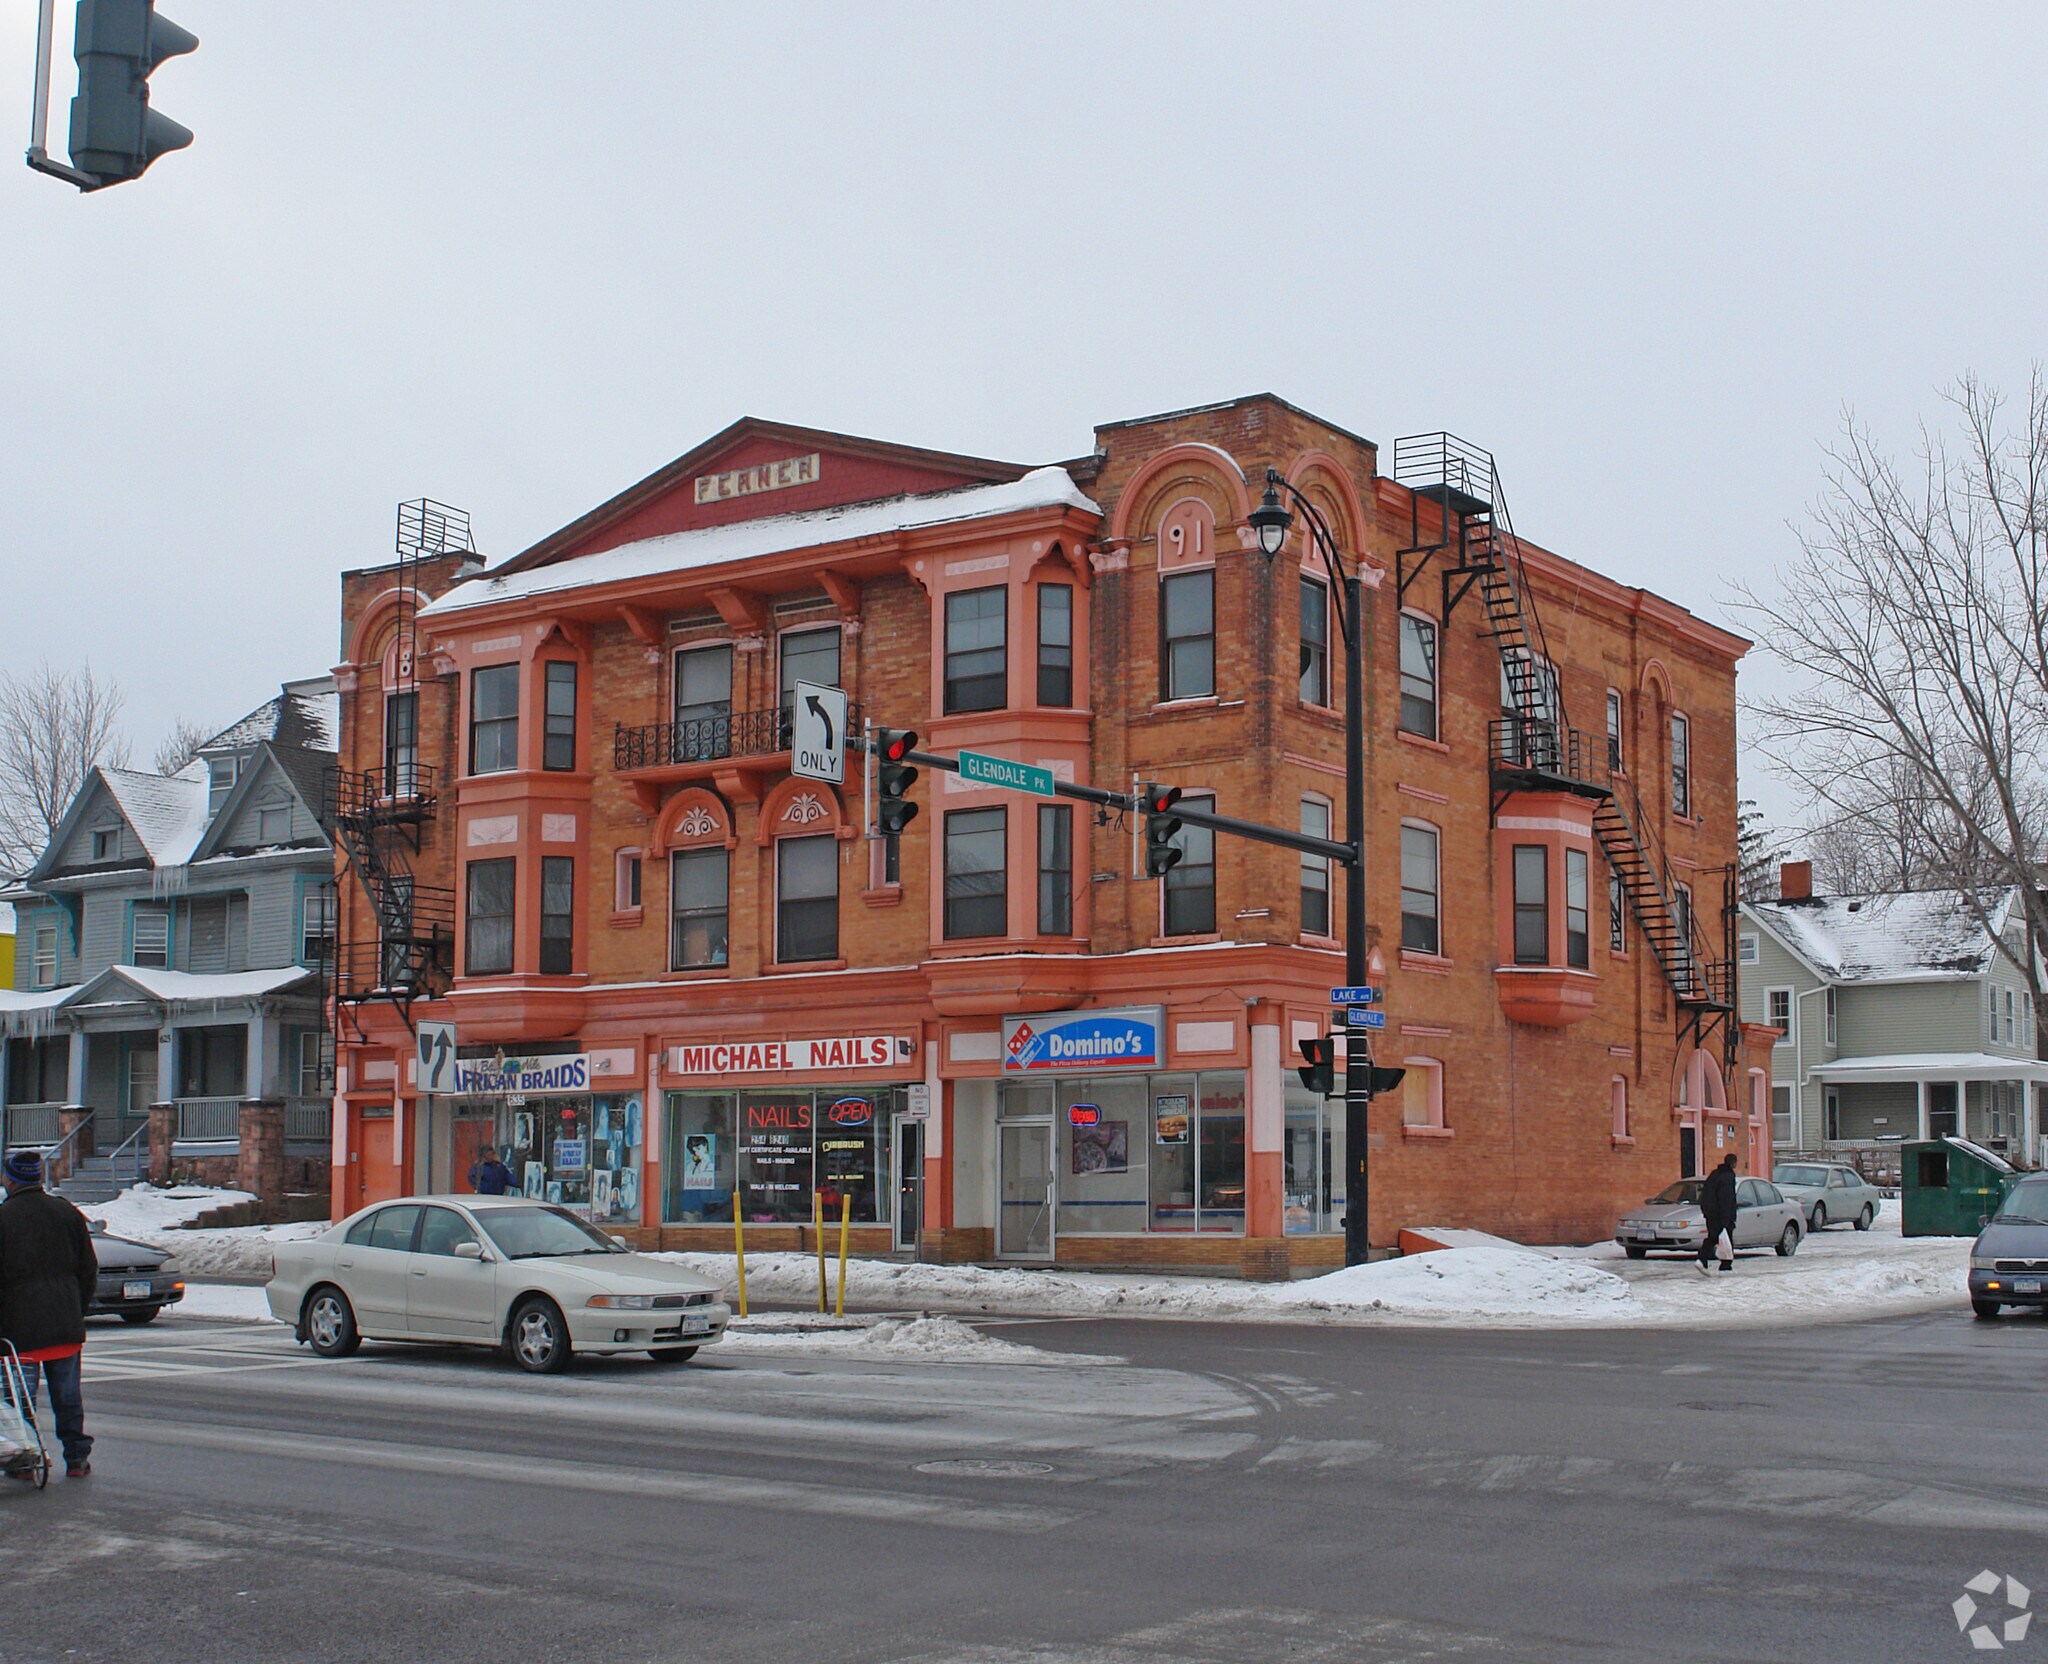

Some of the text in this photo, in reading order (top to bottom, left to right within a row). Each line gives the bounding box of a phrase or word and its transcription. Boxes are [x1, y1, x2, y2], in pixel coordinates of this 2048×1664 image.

[1169, 519, 1202, 556] 91
[800, 750, 837, 773] ONLY
[967, 758, 1045, 789] GLENDALE PK
[1332, 990, 1357, 1001] LAKE
[1350, 1011, 1378, 1024] GLENDALE
[683, 1038, 888, 1072] MICHAEL NAILS
[1050, 1030, 1142, 1057] Domino's
[521, 1058, 586, 1090] BRAIDS
[748, 1104, 811, 1128] NAILS
[828, 1102, 873, 1121] OPEN
[1071, 1106, 1097, 1125] Open
